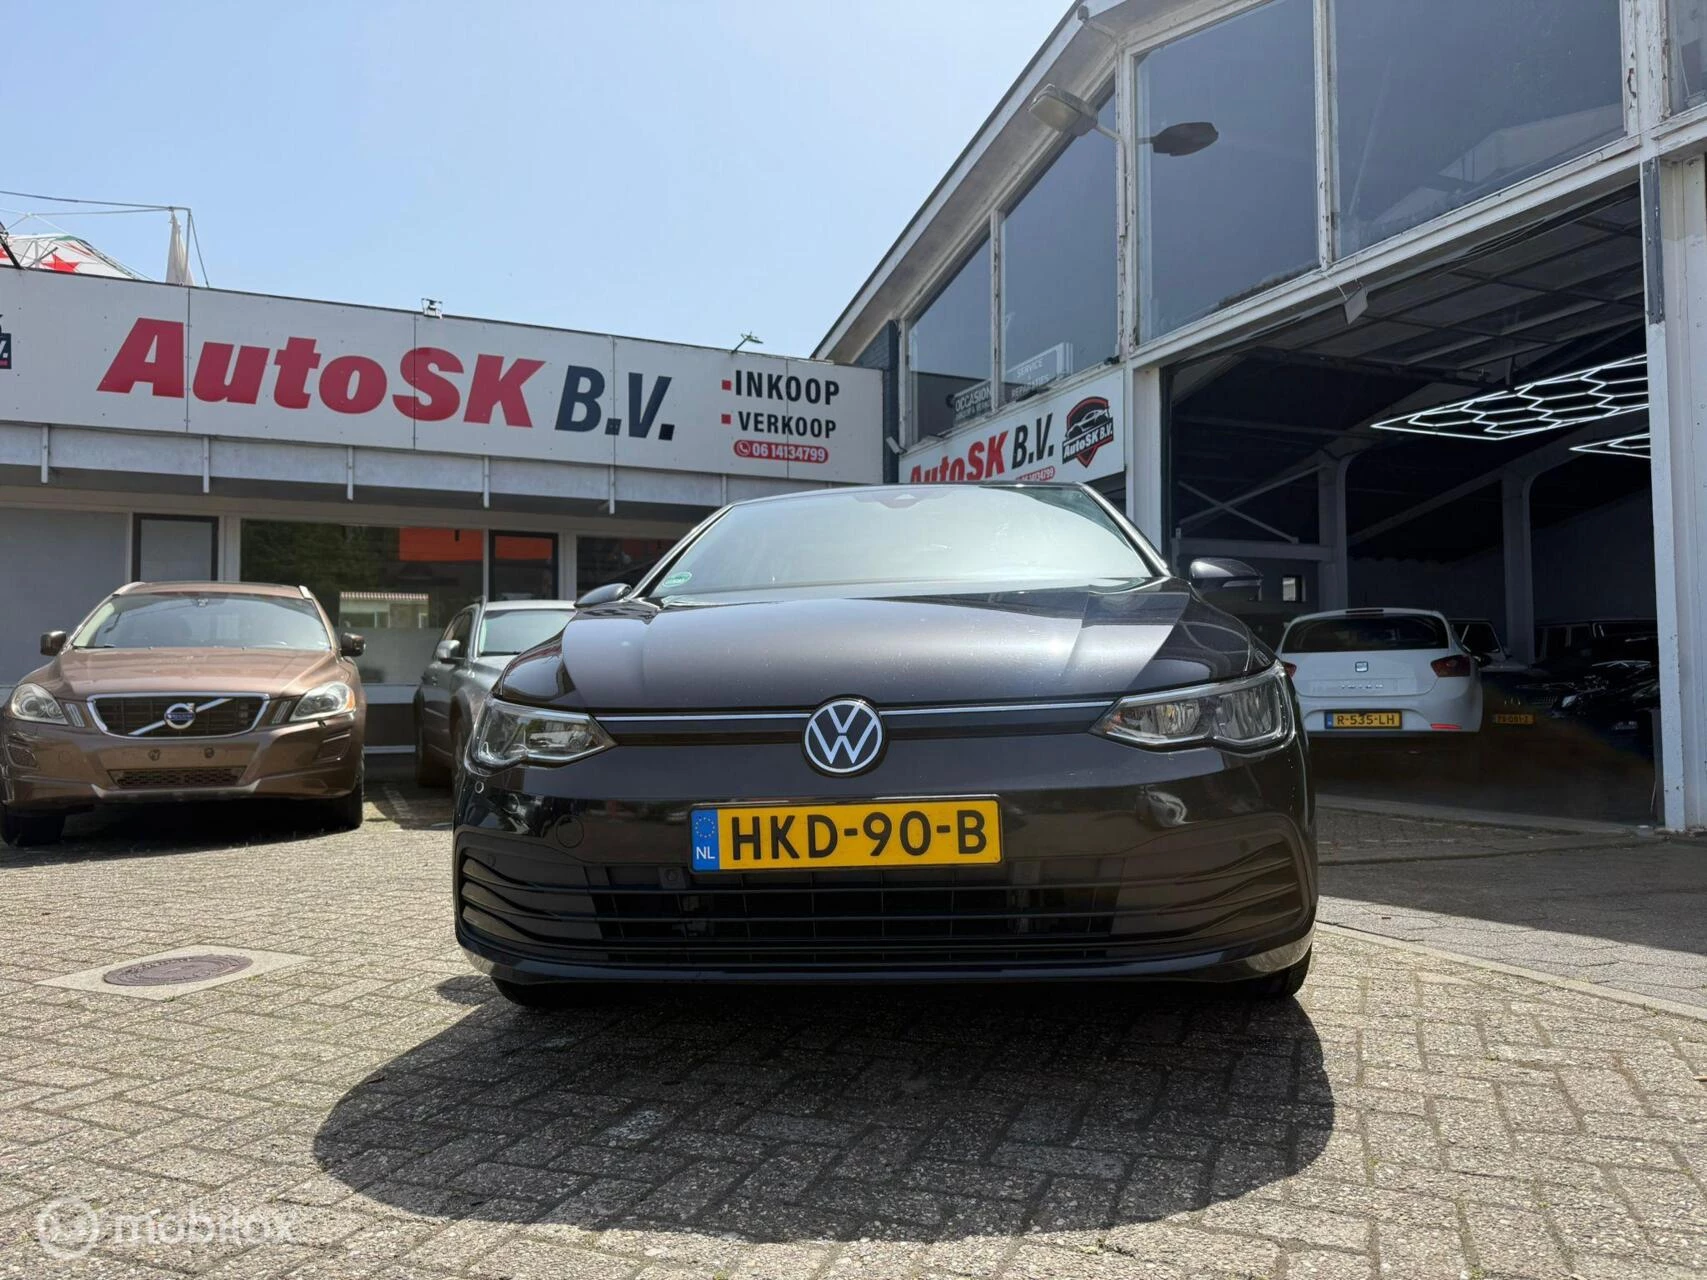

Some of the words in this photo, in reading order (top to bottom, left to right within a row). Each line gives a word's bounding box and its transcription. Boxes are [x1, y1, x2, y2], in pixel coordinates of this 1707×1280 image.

[96, 317, 546, 428] AutoSK
[554, 365, 675, 441] B.V.
[735, 370, 839, 405] INKOOP
[738, 411, 836, 438] VERKOOP
[1012, 413, 1054, 469] B.V.
[1064, 430, 1099, 458] AutoSK
[1099, 422, 1113, 439] B.V.
[752, 443, 768, 456] 06
[1336, 714, 1396, 725] R-535-LH
[731, 810, 987, 860] HKD-90-B
[696, 846, 715, 860] NL
